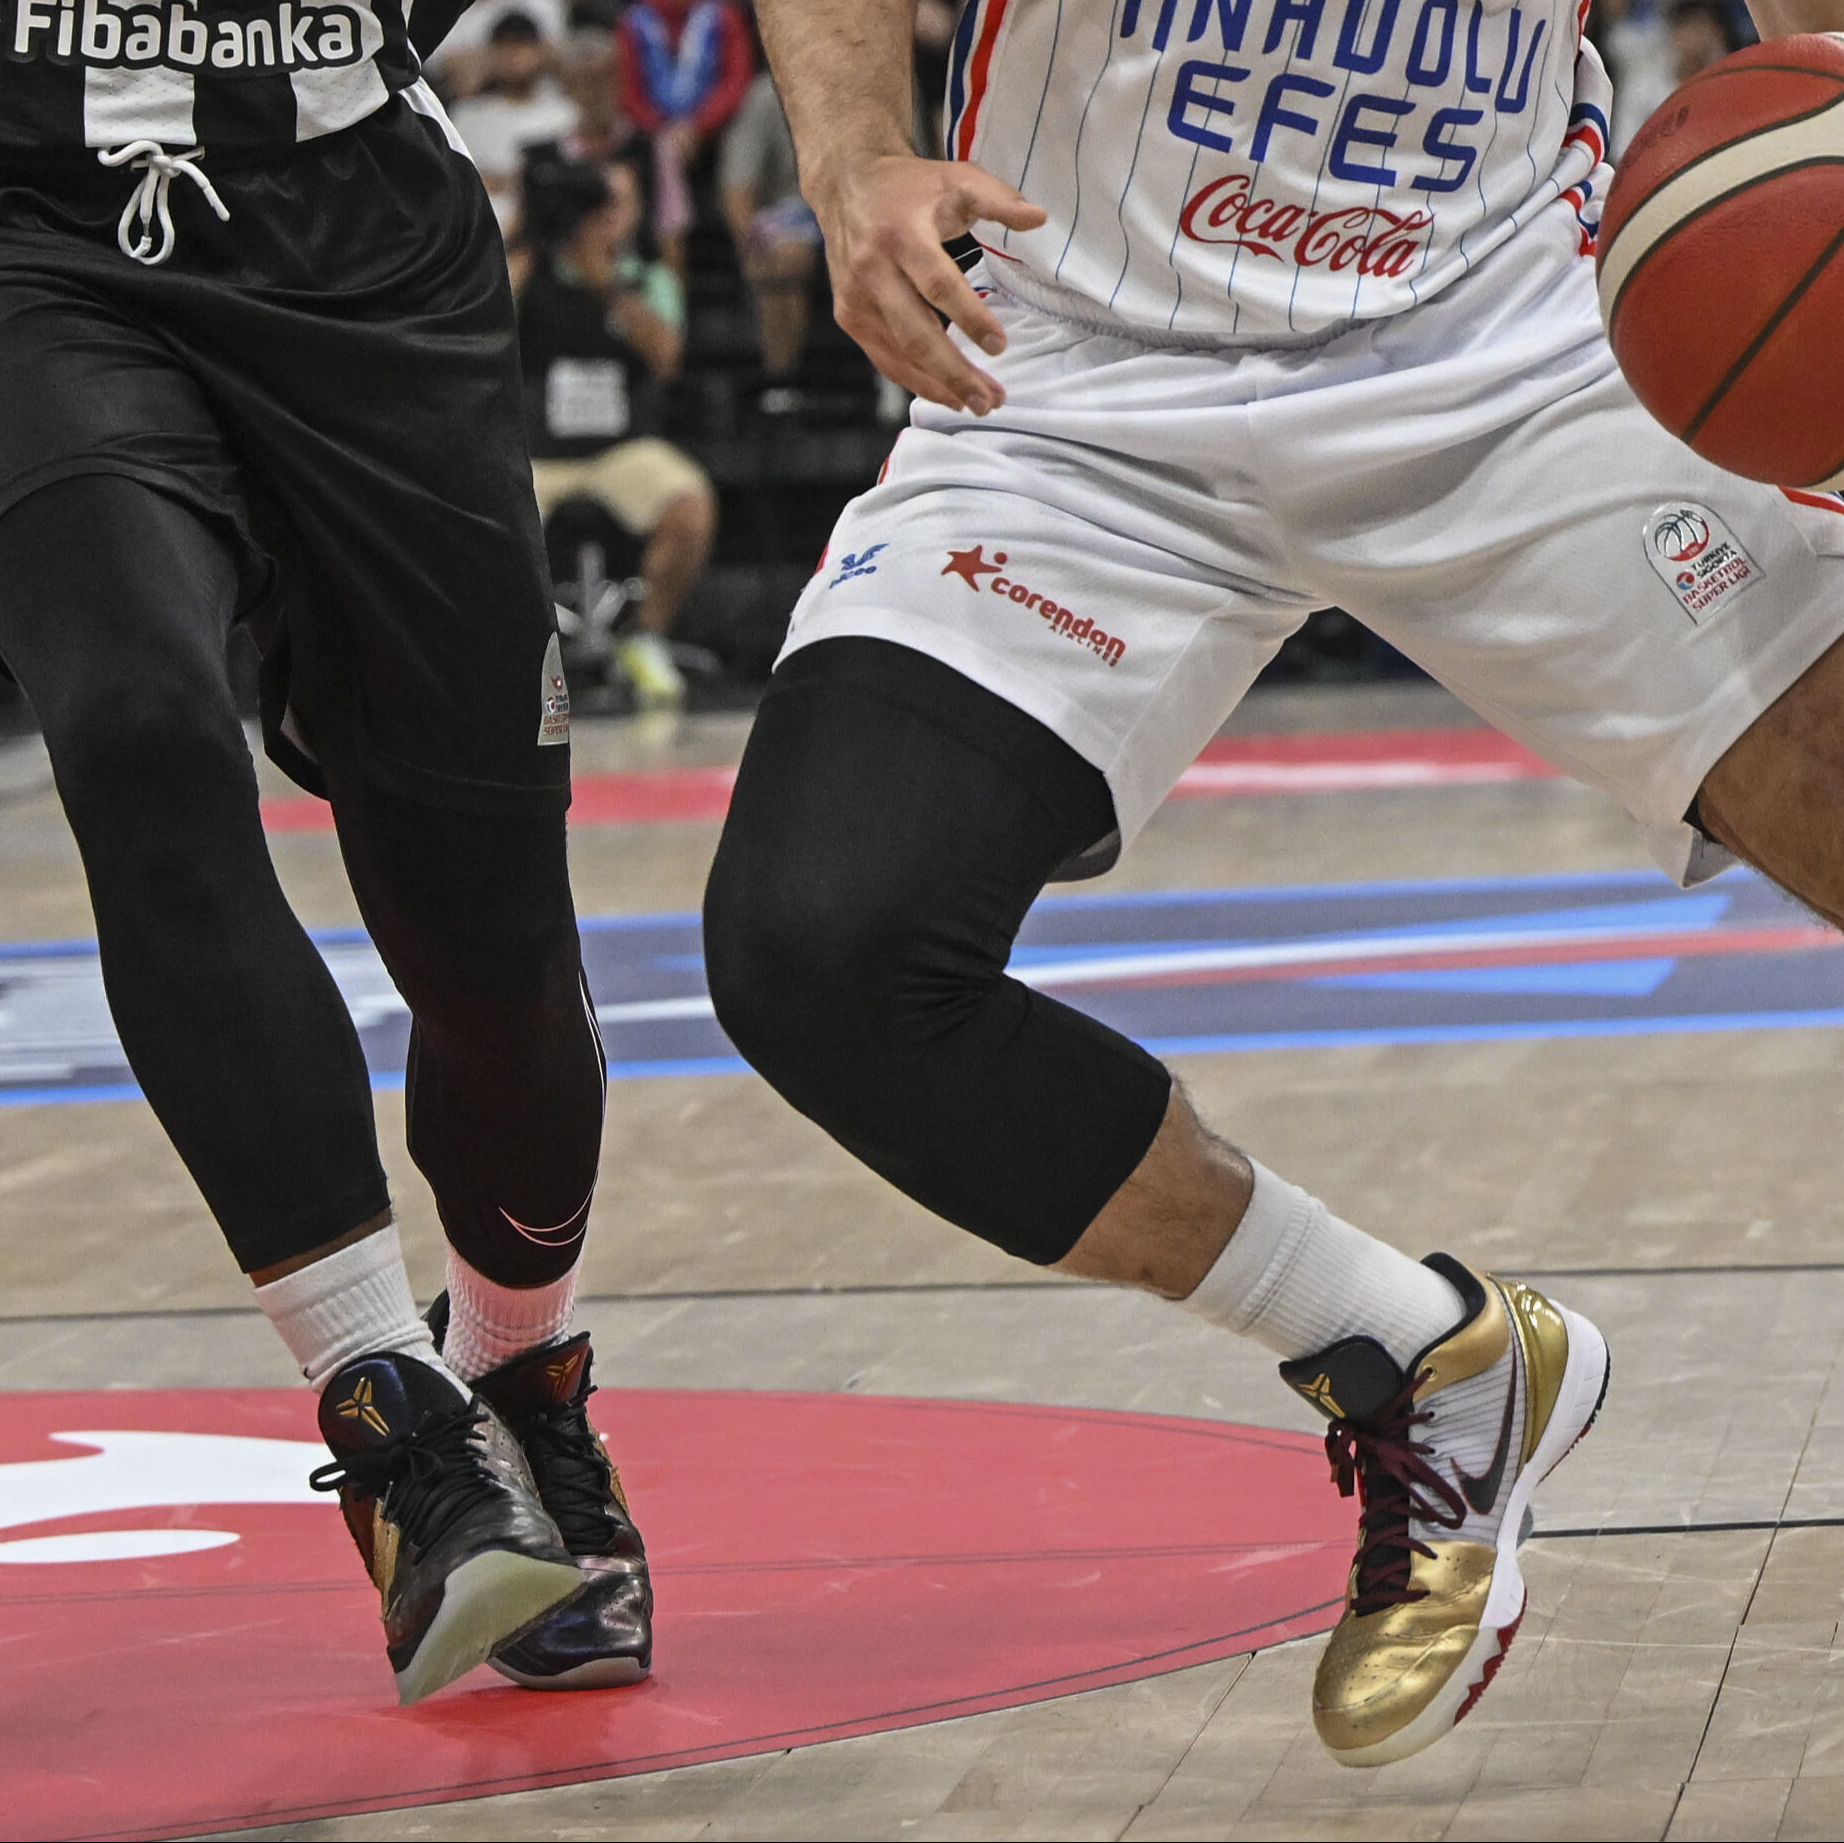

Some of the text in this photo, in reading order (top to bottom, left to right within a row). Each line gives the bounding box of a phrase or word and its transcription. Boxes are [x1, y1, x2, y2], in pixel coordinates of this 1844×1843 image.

[1166, 60, 1484, 193] EFES
[1179, 174, 1436, 279] Coca-Cola
[989, 575, 1128, 660] corendon
[1048, 623, 1119, 668] AIRLINES
